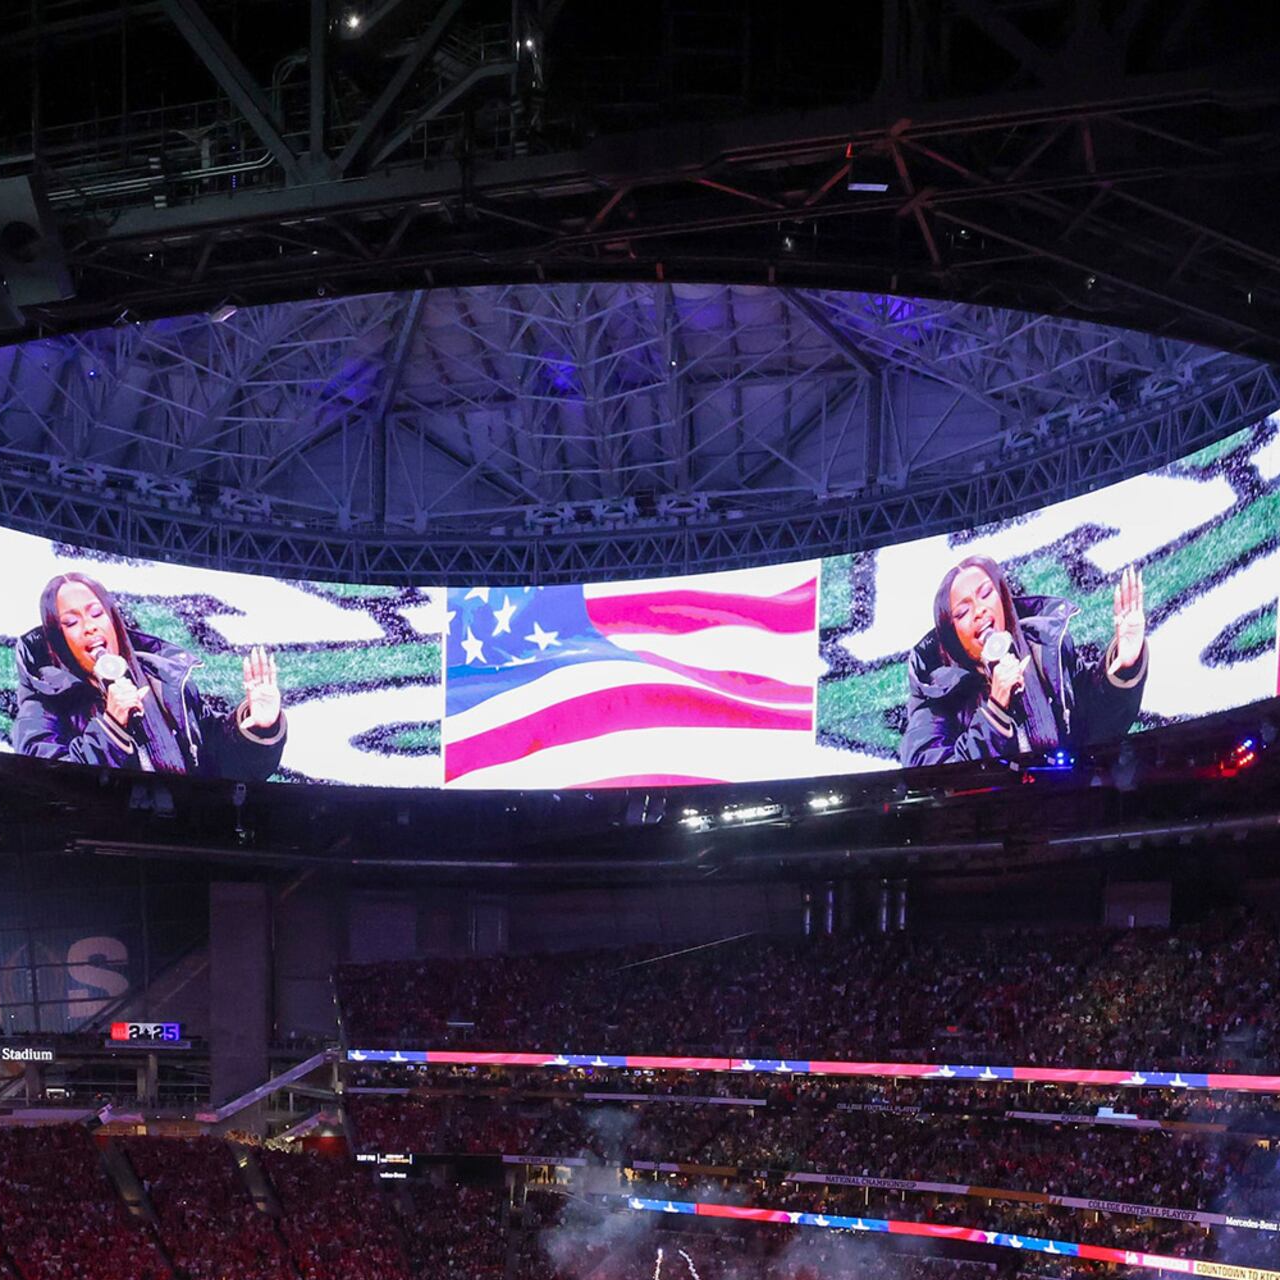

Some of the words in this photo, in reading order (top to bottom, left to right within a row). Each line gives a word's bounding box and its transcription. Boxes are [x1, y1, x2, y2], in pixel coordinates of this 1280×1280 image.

[2, 1047, 54, 1061] Stadium
[825, 1175, 860, 1186] NATIONAL
[860, 1178, 917, 1189] CHAMPIONSHIP
[1088, 1200, 1121, 1213] COLLEGE
[1121, 1202, 1161, 1217] FOOTBALL
[1161, 1207, 1197, 1221] PLAYOFF
[1225, 1215, 1278, 1232] Mercedes-Benz
[1196, 1262, 1246, 1280] COUNTDOWN
[1248, 1269, 1259, 1280] TO
